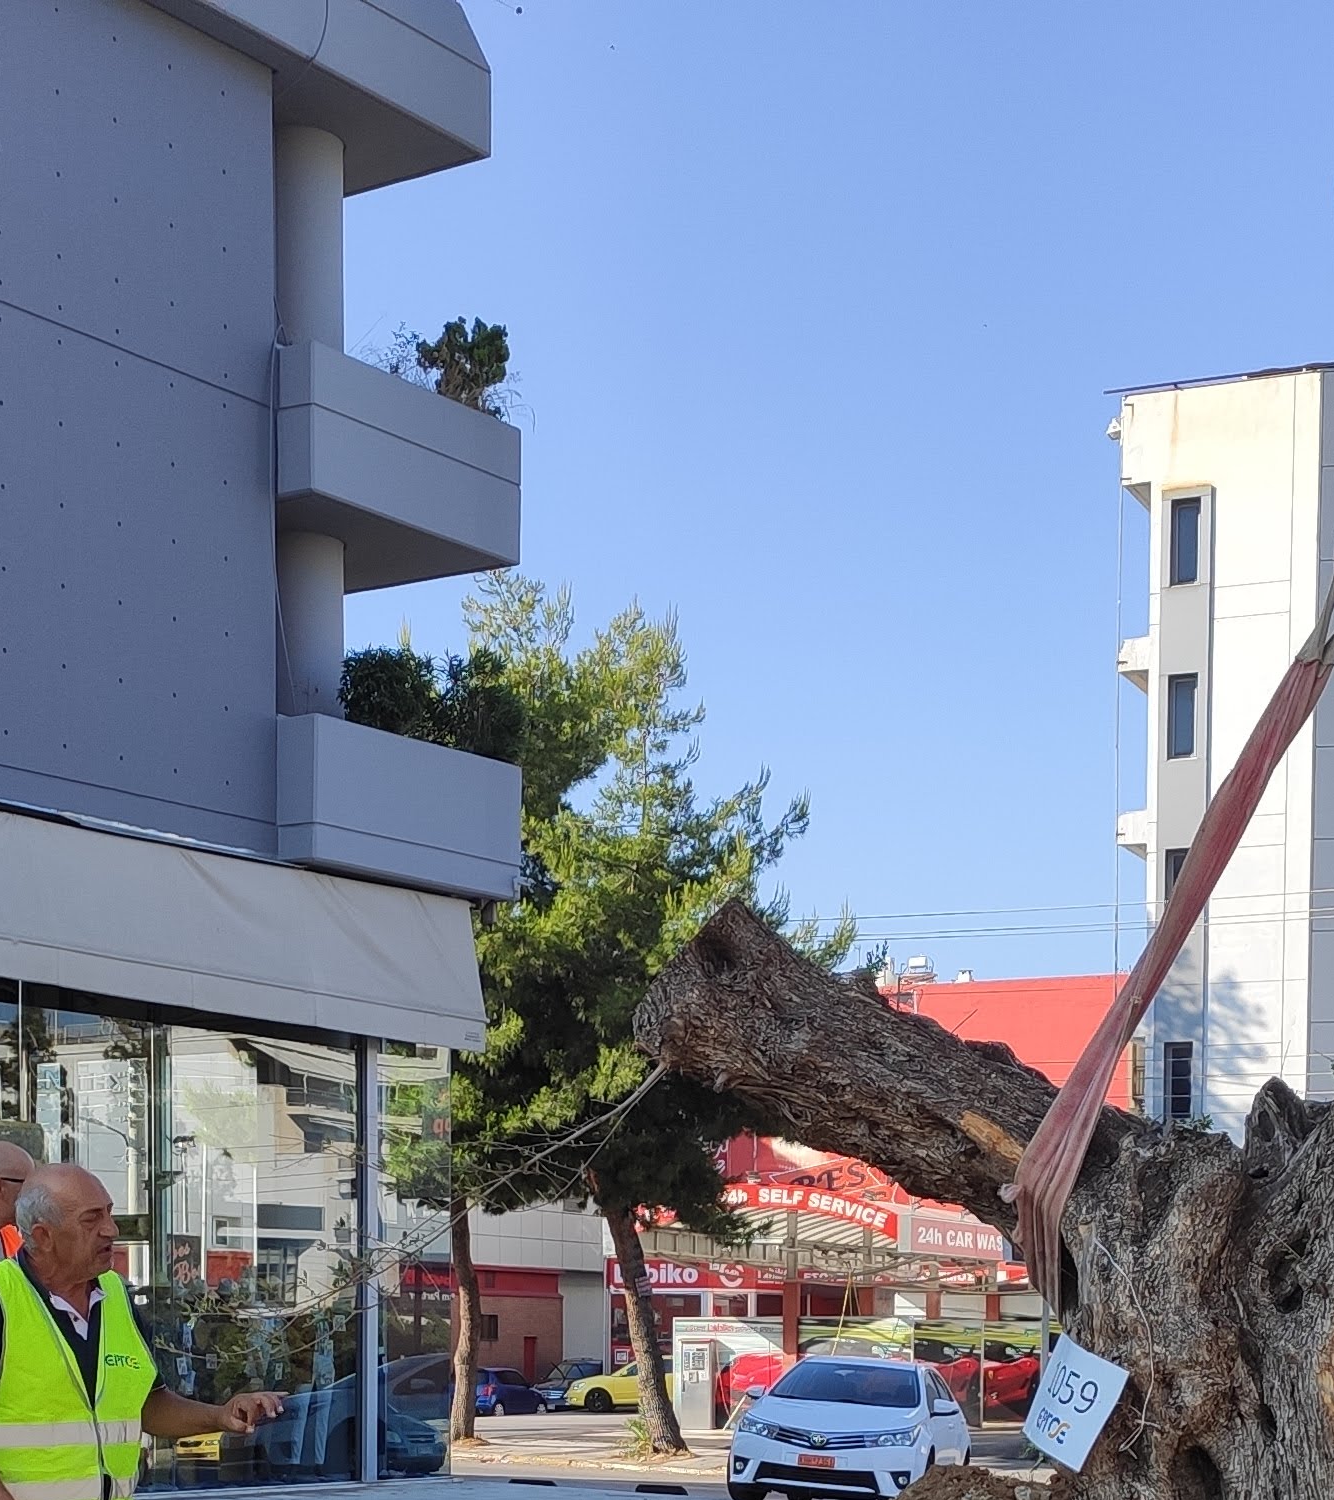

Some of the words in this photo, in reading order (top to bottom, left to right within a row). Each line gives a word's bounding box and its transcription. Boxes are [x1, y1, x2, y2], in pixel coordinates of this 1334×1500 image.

[758, 1188, 804, 1205] SELF
[808, 1191, 889, 1229] SERVICE
[916, 1225, 942, 1245] 24h
[946, 1229, 973, 1249] CAR
[1047, 1361, 1099, 1414] 1059
